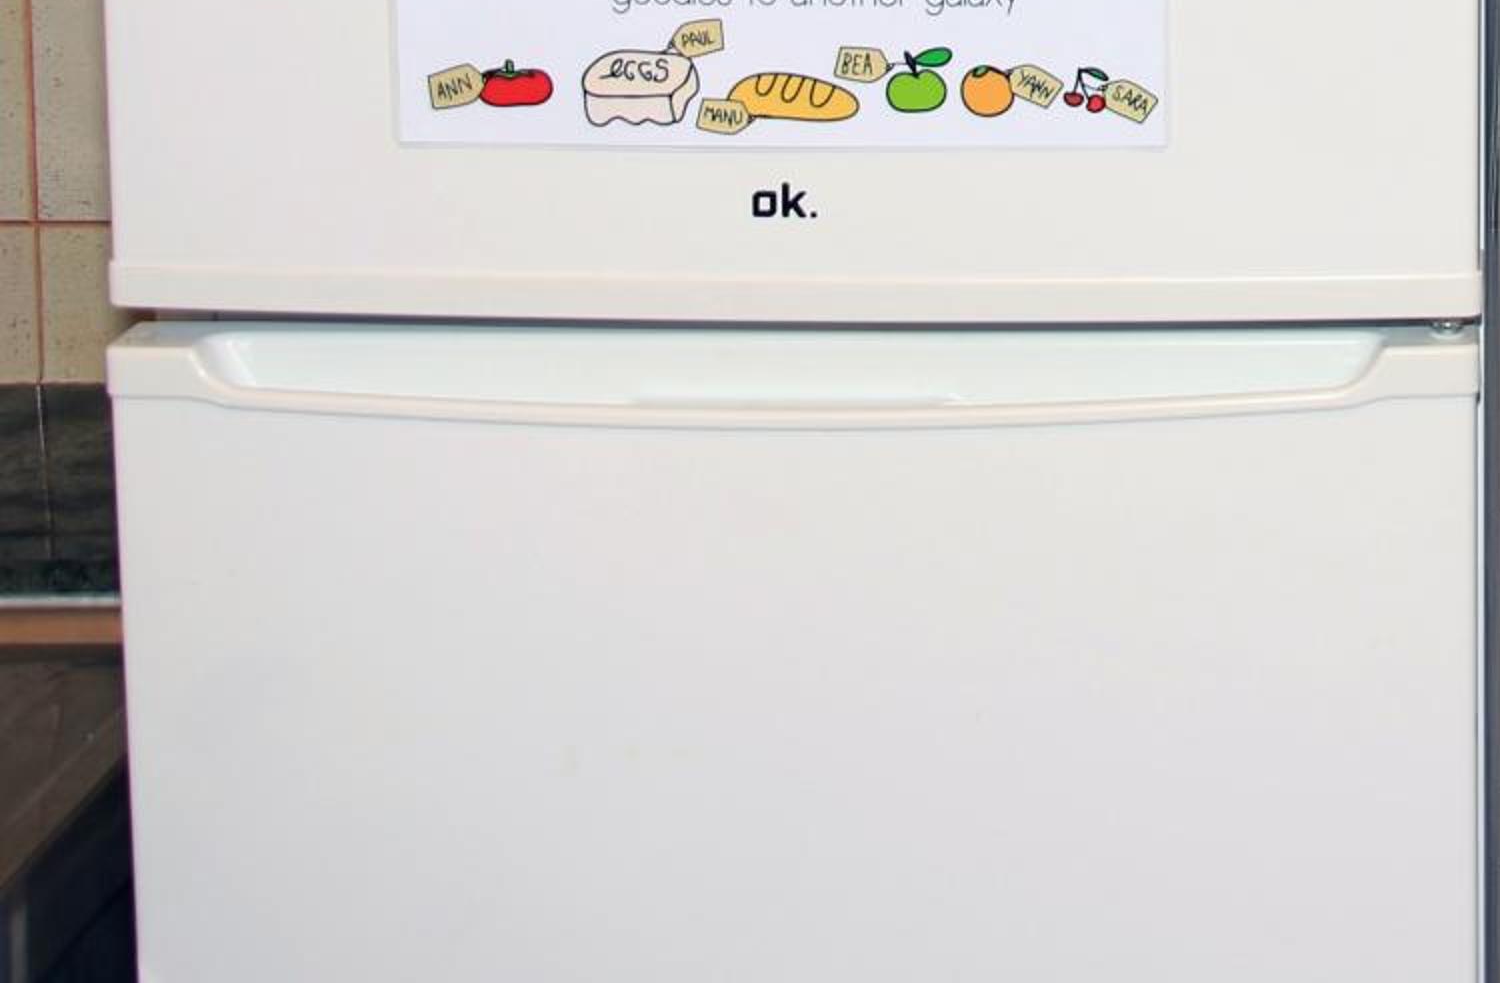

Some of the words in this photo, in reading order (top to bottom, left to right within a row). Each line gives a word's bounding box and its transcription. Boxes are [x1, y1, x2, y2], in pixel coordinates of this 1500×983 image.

[680, 31, 714, 51] PAUL
[841, 53, 874, 75] BEA
[436, 76, 474, 101] ANN
[1018, 71, 1055, 100] YANN
[1112, 85, 1149, 115] SARA
[703, 107, 744, 127] MANU
